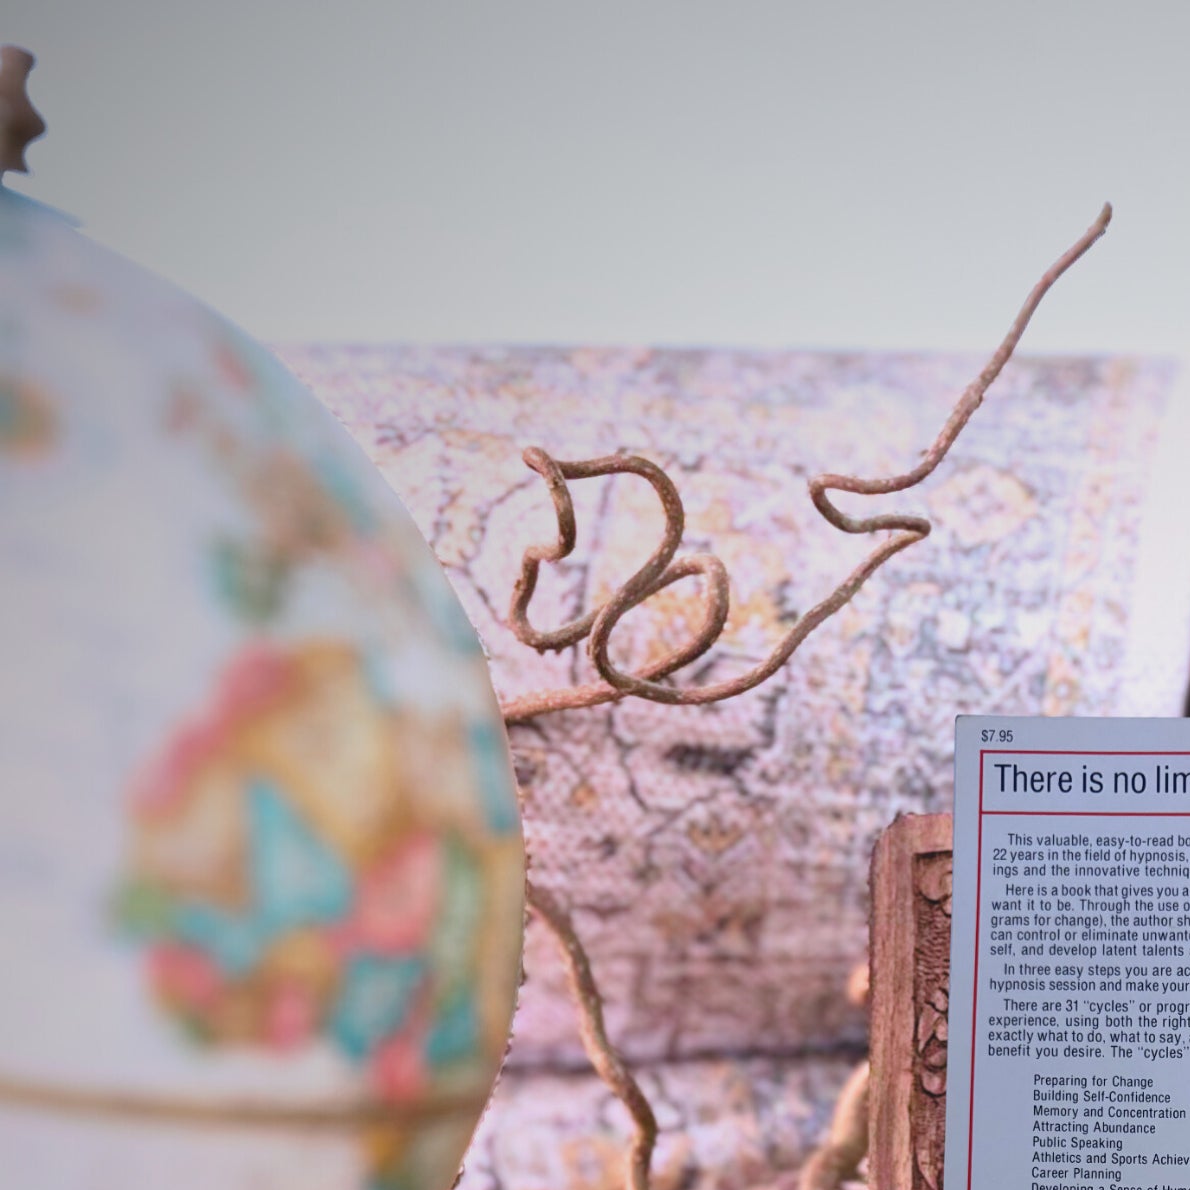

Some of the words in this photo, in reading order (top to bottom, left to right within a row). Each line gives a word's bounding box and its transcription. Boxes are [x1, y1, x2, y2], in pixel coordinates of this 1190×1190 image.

[981, 729, 1014, 742] $7.95
[994, 764, 1073, 793] There
[1082, 764, 1104, 793] is
[1113, 771, 1147, 794] no
[990, 931, 1013, 941] can
[1016, 928, 1060, 941] control
[1064, 931, 1078, 941] or
[1081, 929, 1138, 941] eliminate
[989, 978, 1046, 994] hypnosis
[1048, 979, 1096, 991] session
[1099, 979, 1122, 991] and
[1125, 979, 1159, 992] make
[1161, 982, 1190, 995] your
[1033, 1073, 1088, 1089] Preparing
[1091, 1074, 1108, 1086] for
[1112, 1074, 1154, 1090] Change
[1033, 1090, 1079, 1106] Building
[1083, 1091, 1171, 1104] Self-Confidence
[1033, 1105, 1079, 1120] Memory
[1083, 1105, 1104, 1118] and
[1108, 1106, 1186, 1118] Concentration
[1032, 1120, 1089, 1136] Attracting
[1093, 1121, 1156, 1134] Abundance
[1032, 1135, 1067, 1148] Public
[1070, 1136, 1123, 1151] Speaking
[1032, 1151, 1082, 1163] Athletics
[1086, 1151, 1107, 1164] and
[1111, 1152, 1148, 1168] Sports
[1031, 1166, 1069, 1179] Career
[1073, 1167, 1122, 1182] Planning
